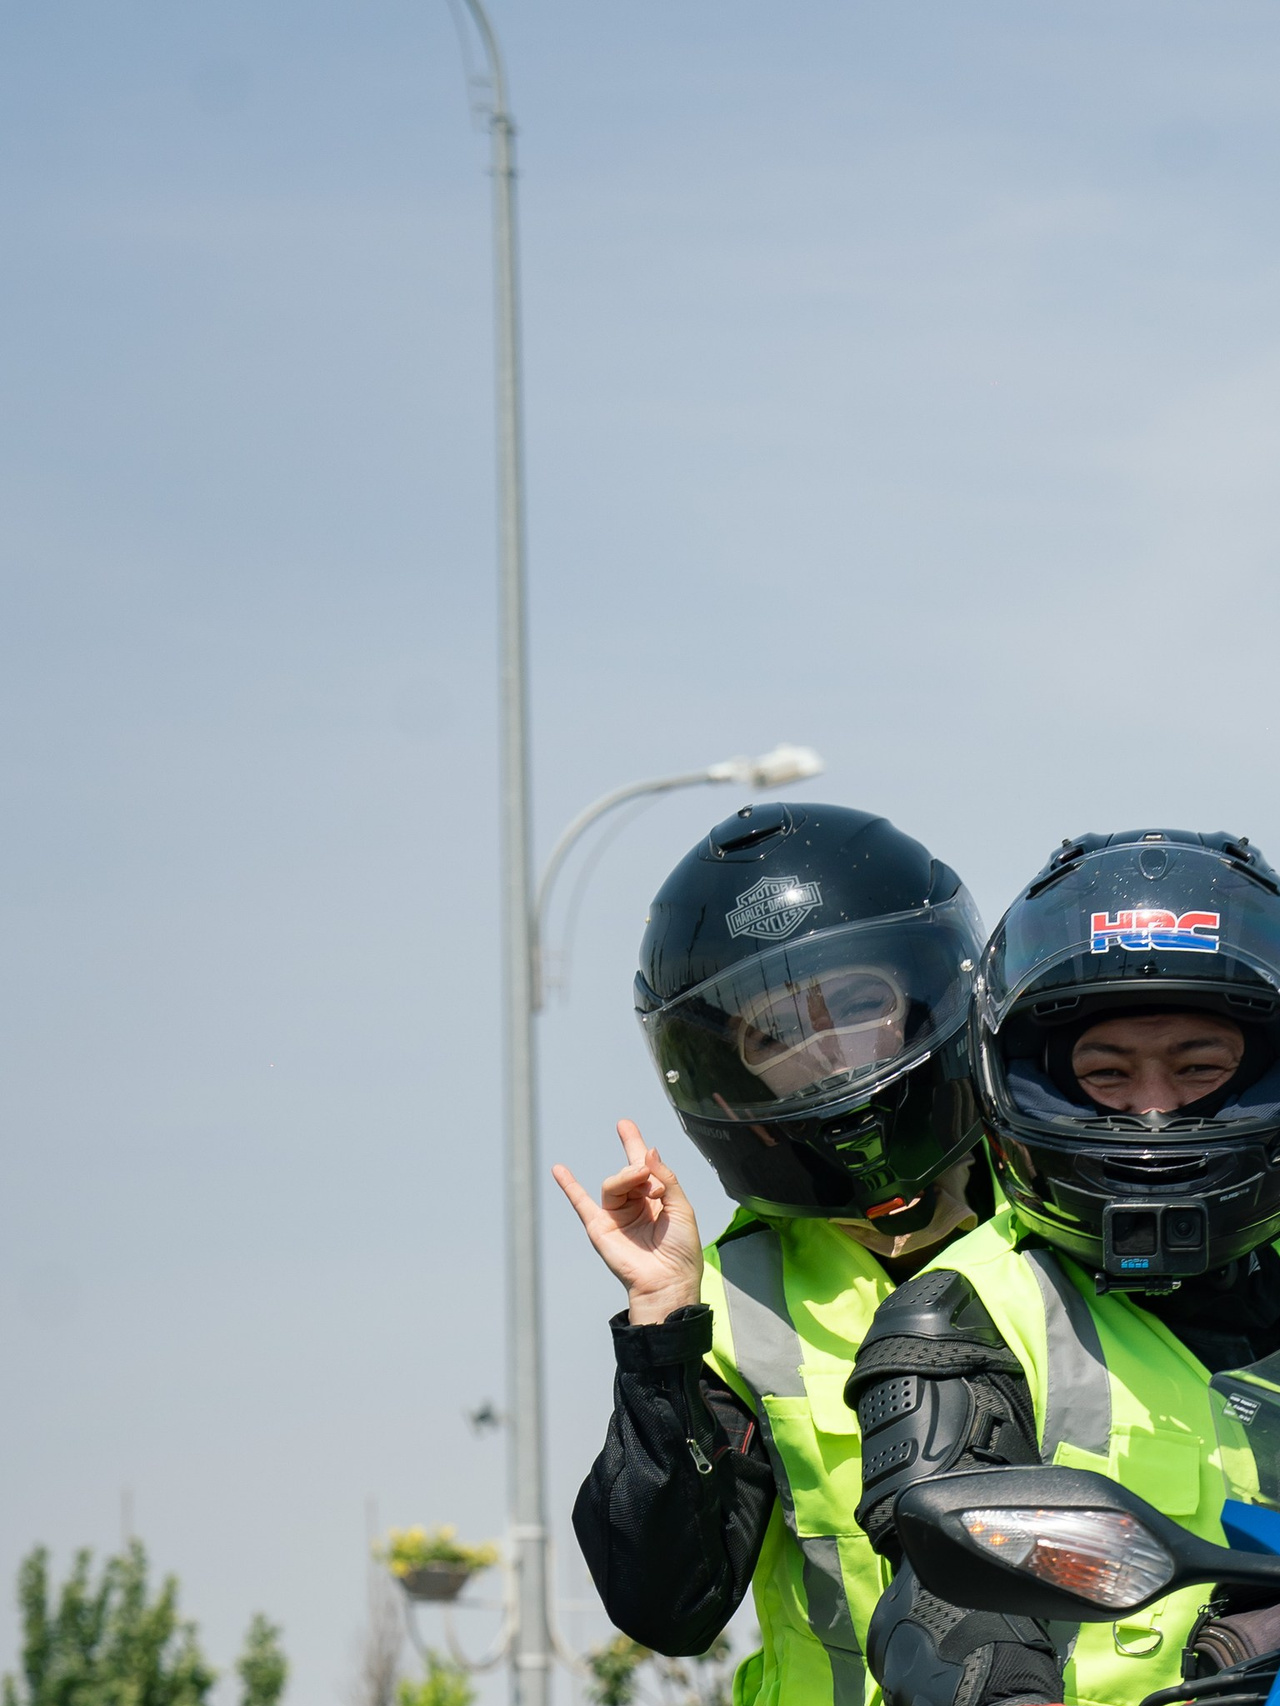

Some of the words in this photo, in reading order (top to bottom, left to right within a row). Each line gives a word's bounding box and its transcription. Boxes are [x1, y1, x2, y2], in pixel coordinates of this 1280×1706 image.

[734, 888, 813, 927] HARLEY-DAVION
[747, 883, 789, 904] MOTOR
[756, 908, 798, 932] CYCLES
[1091, 909, 1220, 954] HRC
